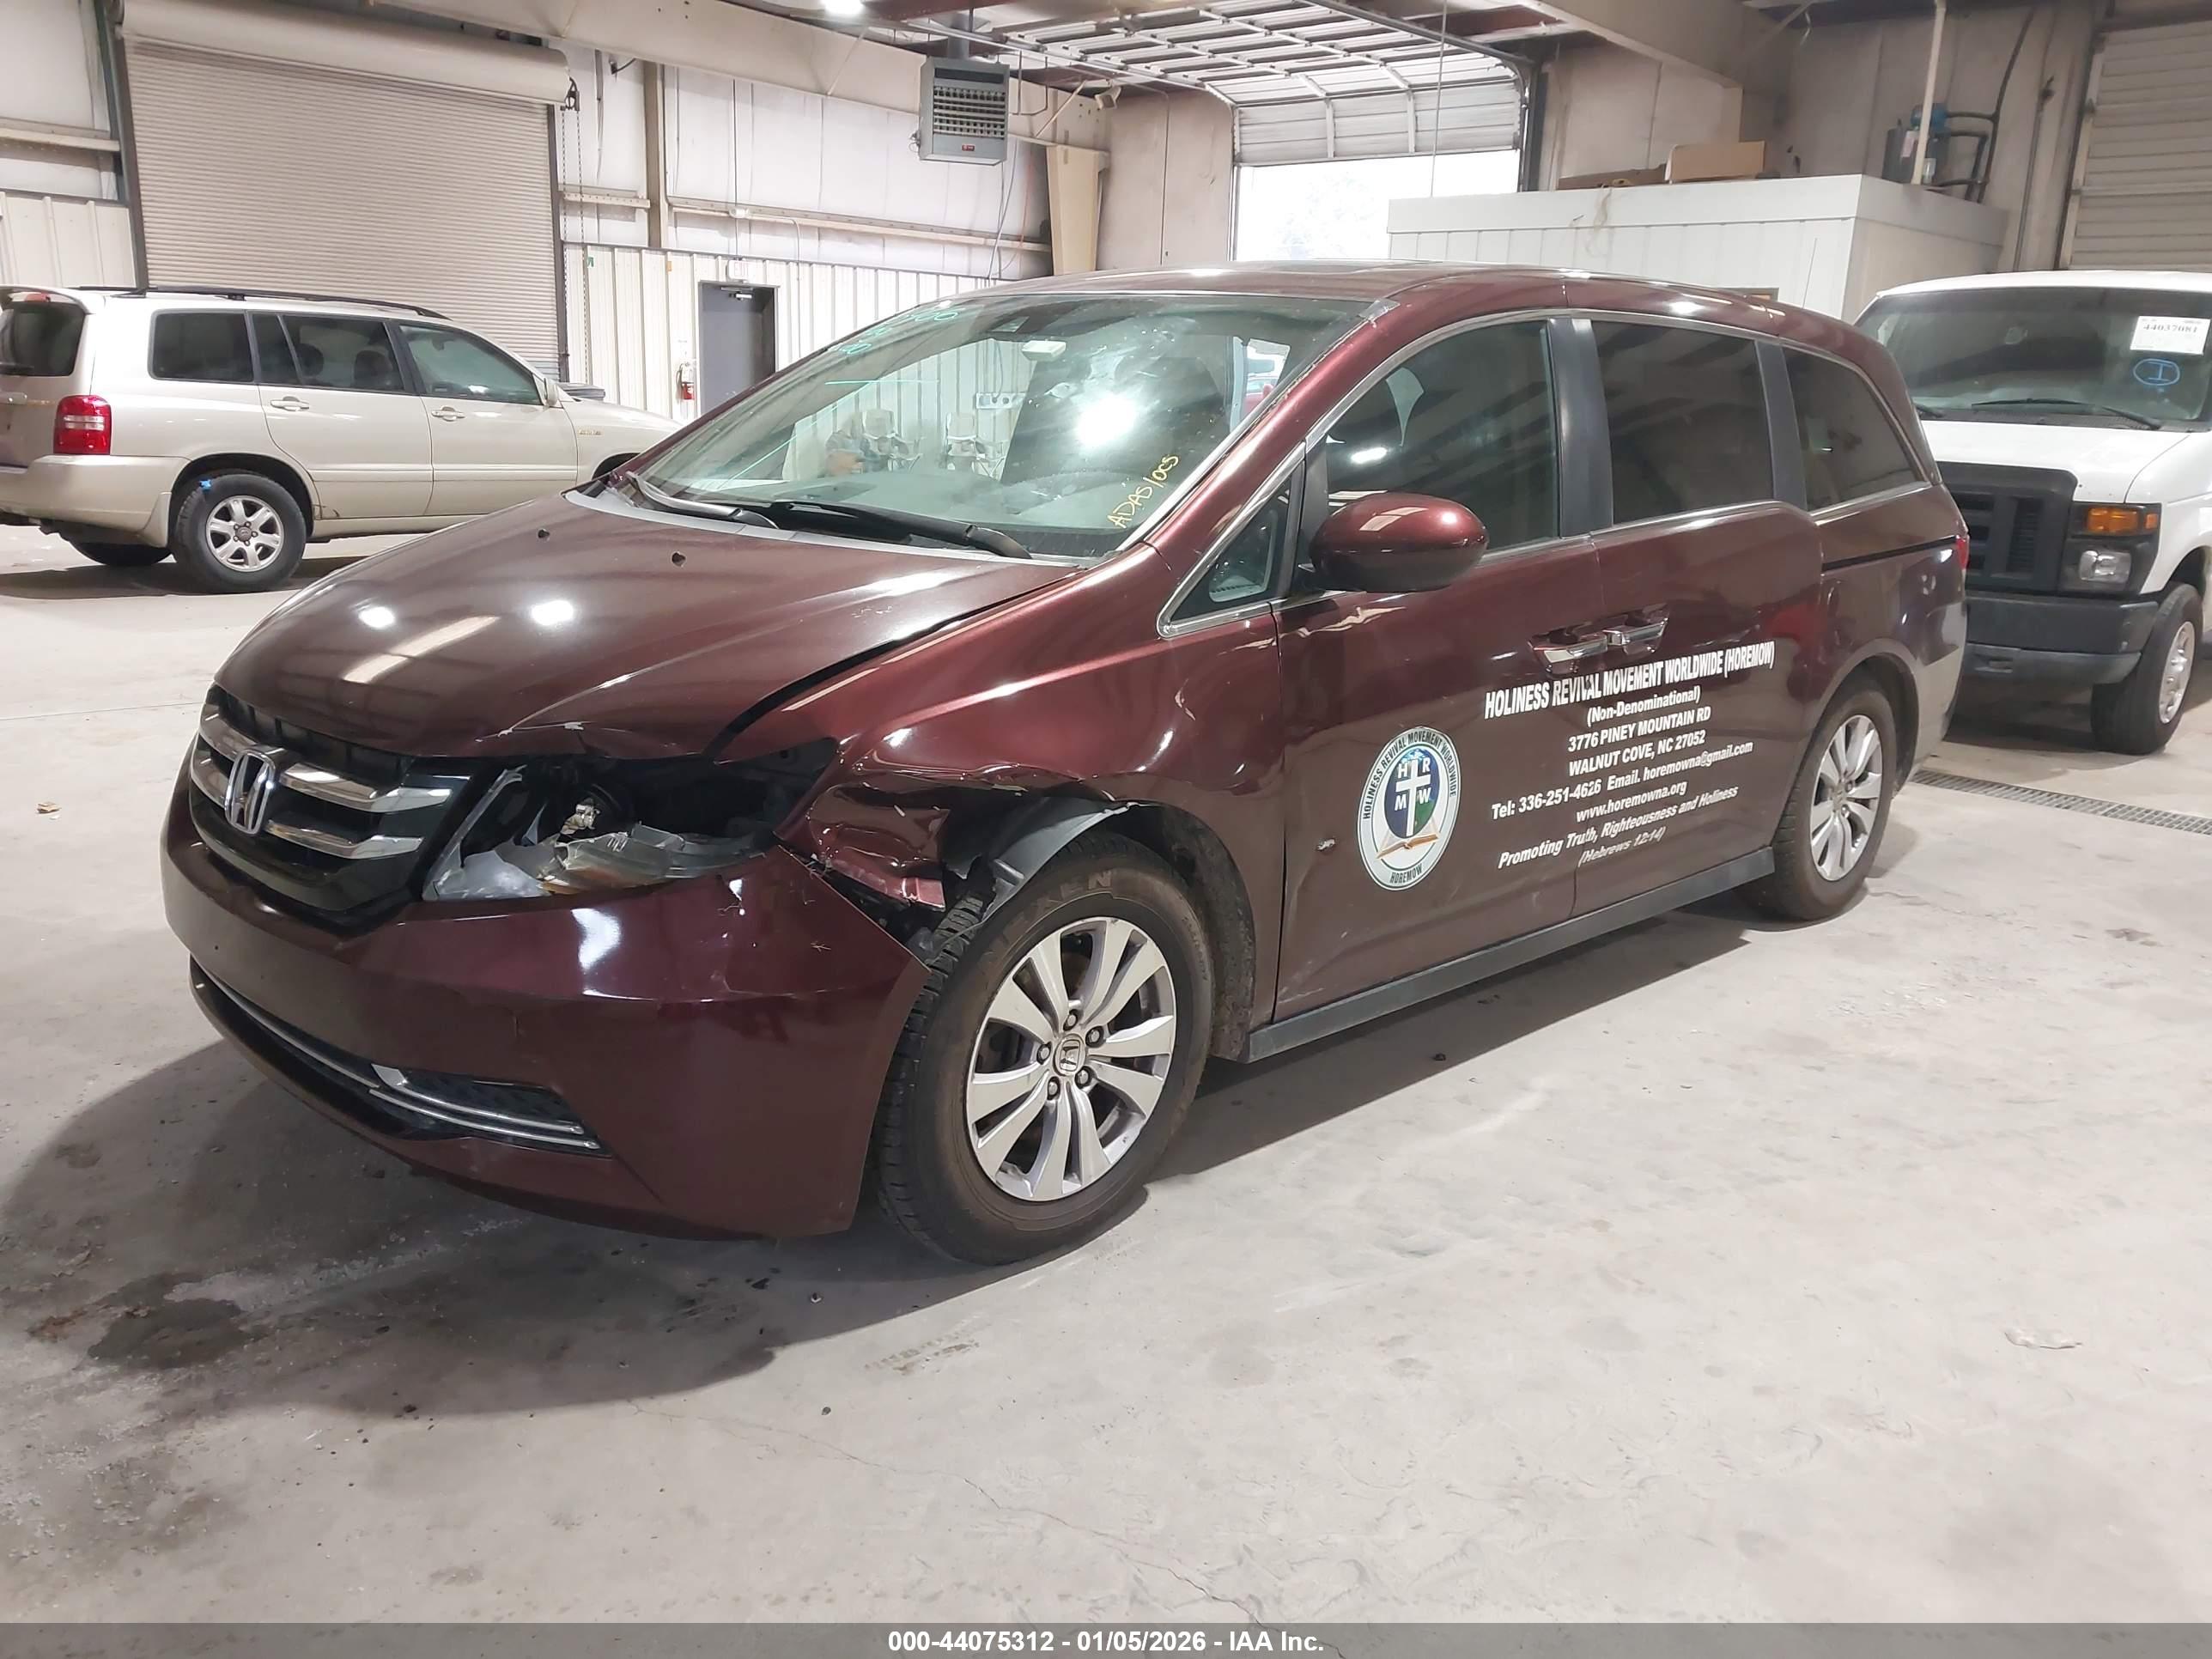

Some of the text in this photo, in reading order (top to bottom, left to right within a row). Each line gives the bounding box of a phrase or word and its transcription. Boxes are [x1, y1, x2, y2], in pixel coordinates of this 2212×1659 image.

[1485, 641, 1775, 720] HOLINESS REVIVAL MOVEMENT WORLDWIDE (HOREMOW)
[1587, 685, 1701, 727] (Non-Denominational)
[1568, 707, 1711, 753] 3776 PINEY MOUNTAIN RD
[1397, 757, 1431, 779] H R
[1569, 730, 1706, 776] WALNUT COVE, NC 27052
[1363, 731, 1457, 820] HOLINESS REVIVAL MOVEMENT WORLDWIDE
[1492, 740, 1753, 819] Tel: 336-251-4626 Email. horemowna@gmail.com
[1395, 787, 1432, 811] M W
[1576, 780, 1687, 823] www.horemowna.org
[1498, 786, 1739, 869] Promoting Truth, Righteousness and Holiness
[1577, 825, 1667, 868] (Hebrews 12:14)
[1389, 864, 1422, 884] HOREMOW
